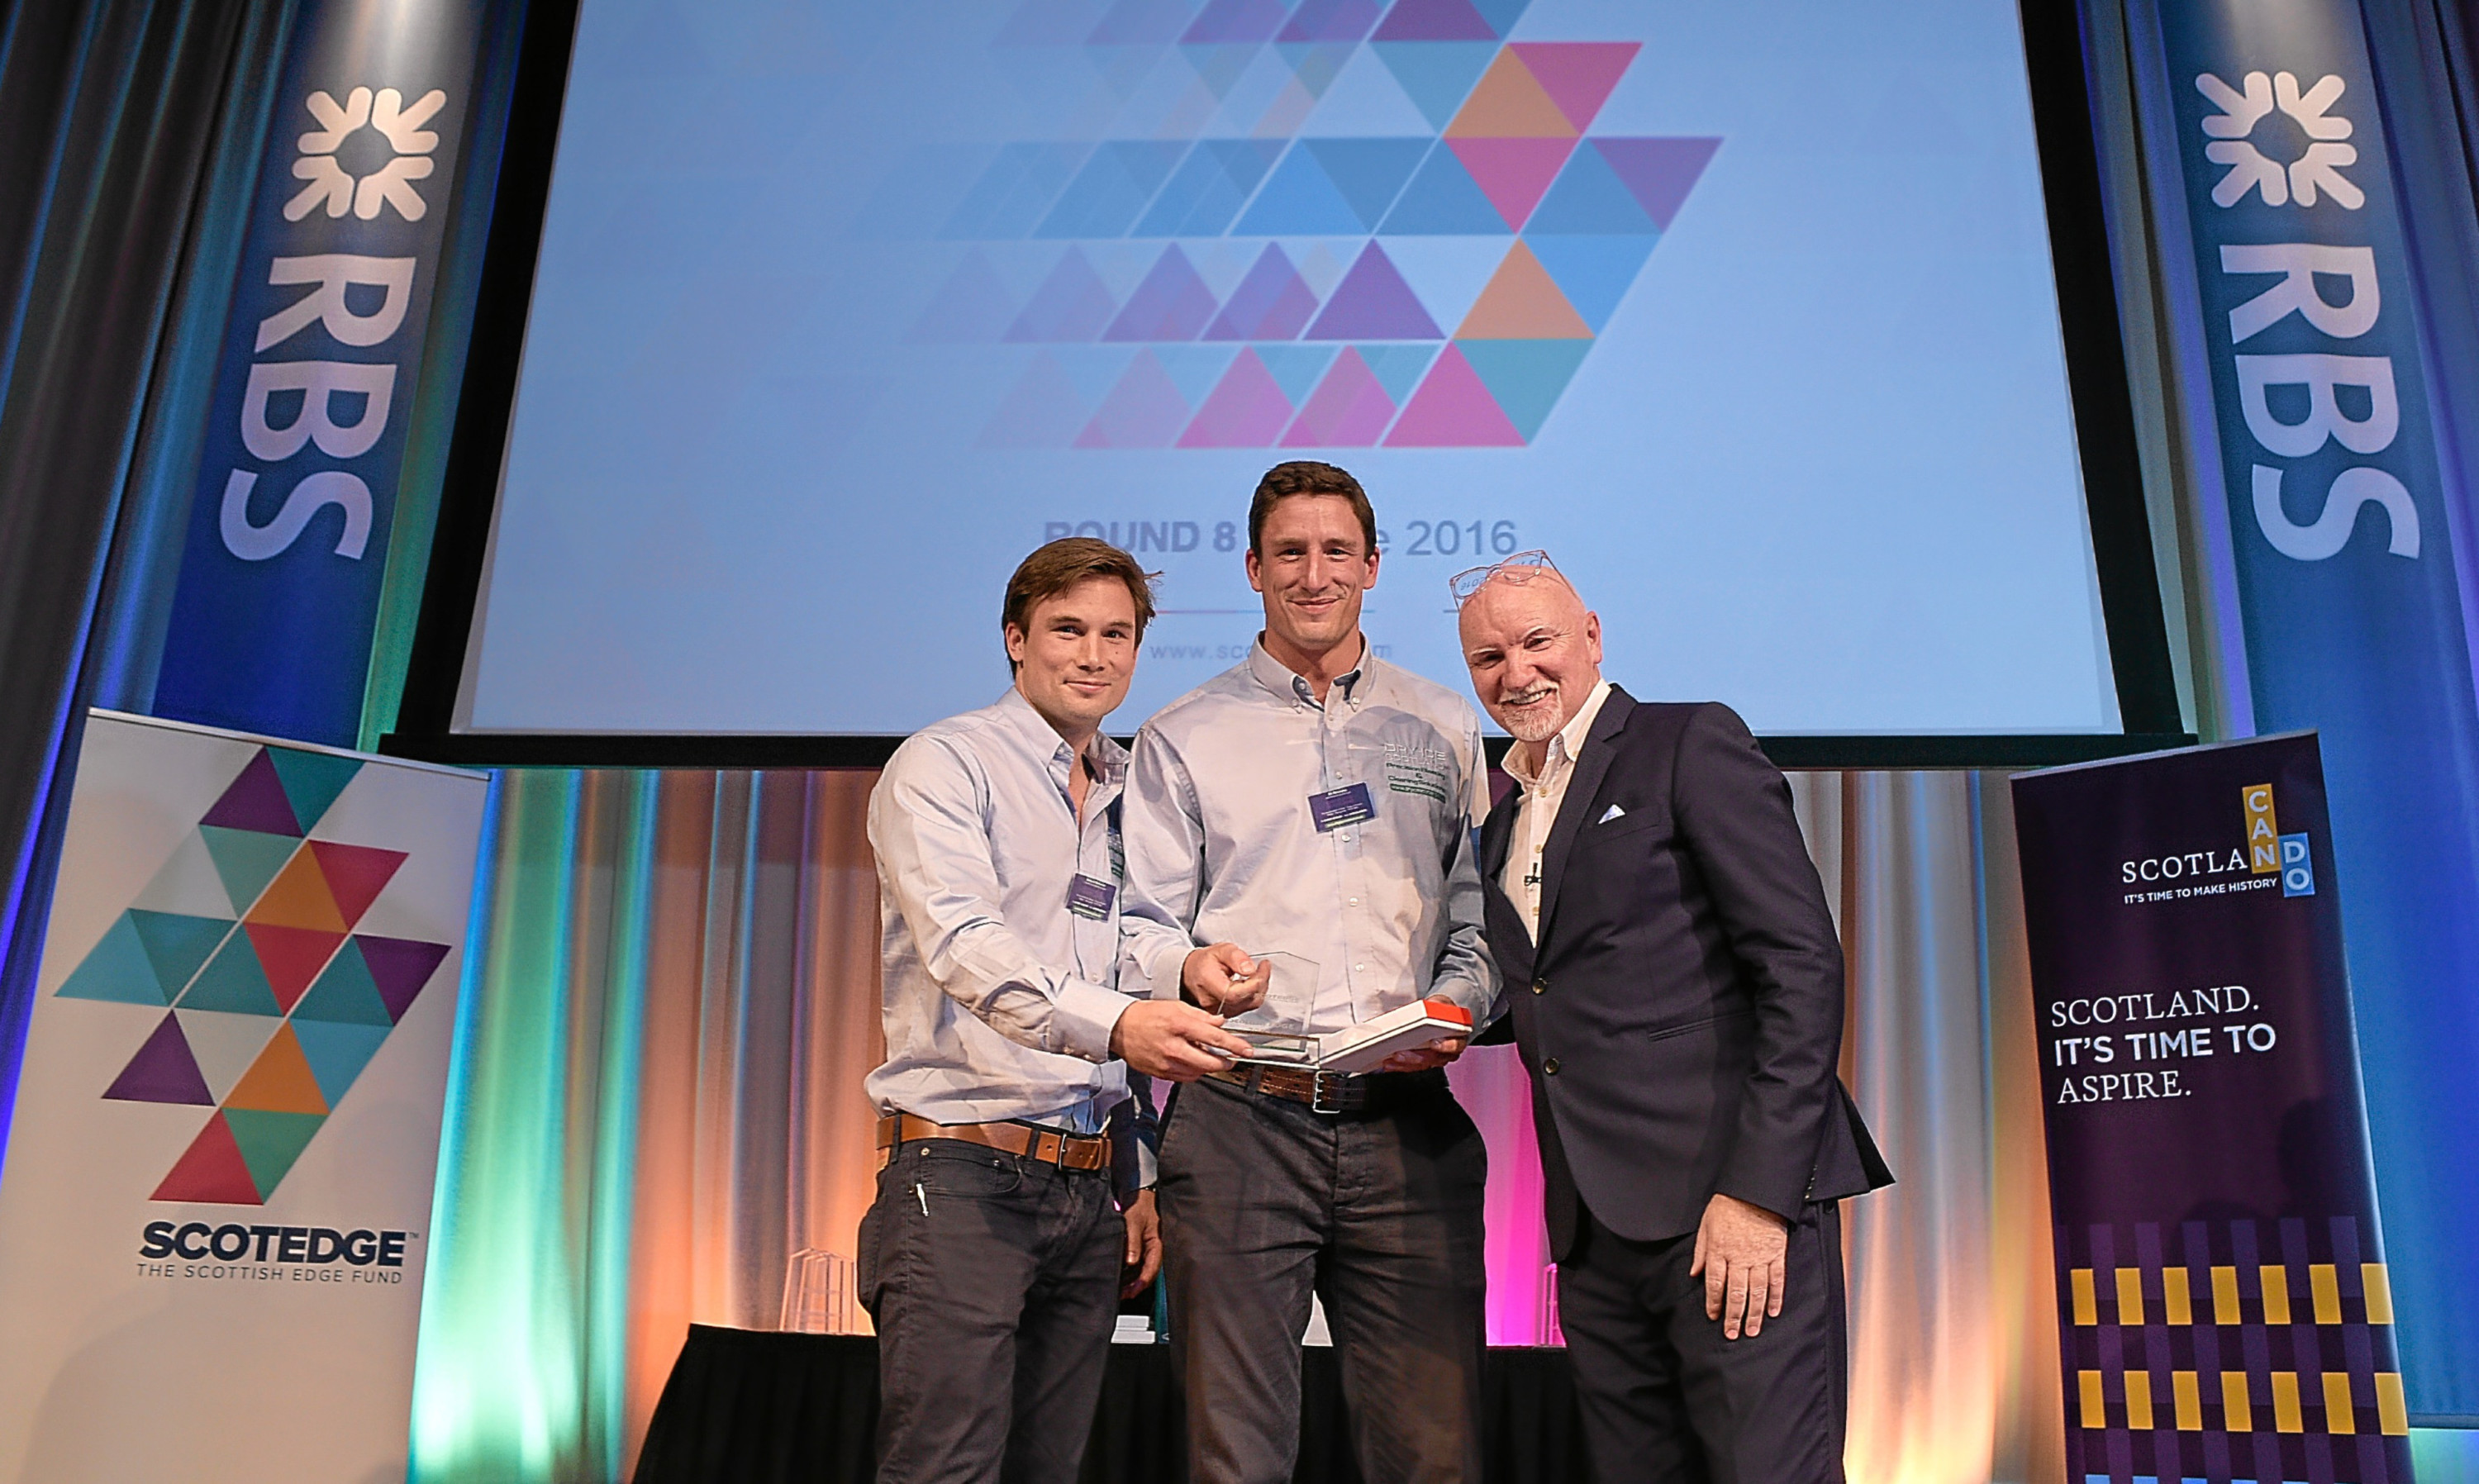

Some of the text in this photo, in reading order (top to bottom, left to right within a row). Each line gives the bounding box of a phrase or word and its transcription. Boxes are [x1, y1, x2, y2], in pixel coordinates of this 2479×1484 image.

[220, 254, 416, 560] RBS
[2220, 244, 2420, 560] RBS
[1213, 521, 1236, 552] 8
[1406, 520, 1516, 555] 2016
[2125, 878, 2277, 904] IT'S TIME TO MAKE HISTORY
[2051, 986, 2259, 1027] SCOTLAND.
[2125, 1028, 2214, 1061] TIME
[2223, 1023, 2277, 1054] TO
[2058, 1070, 2191, 1104] ASPIRE.
[139, 1221, 406, 1267] SCOTEDGE
[137, 1263, 402, 1284] THE SCOTTISH EDGE FUND
